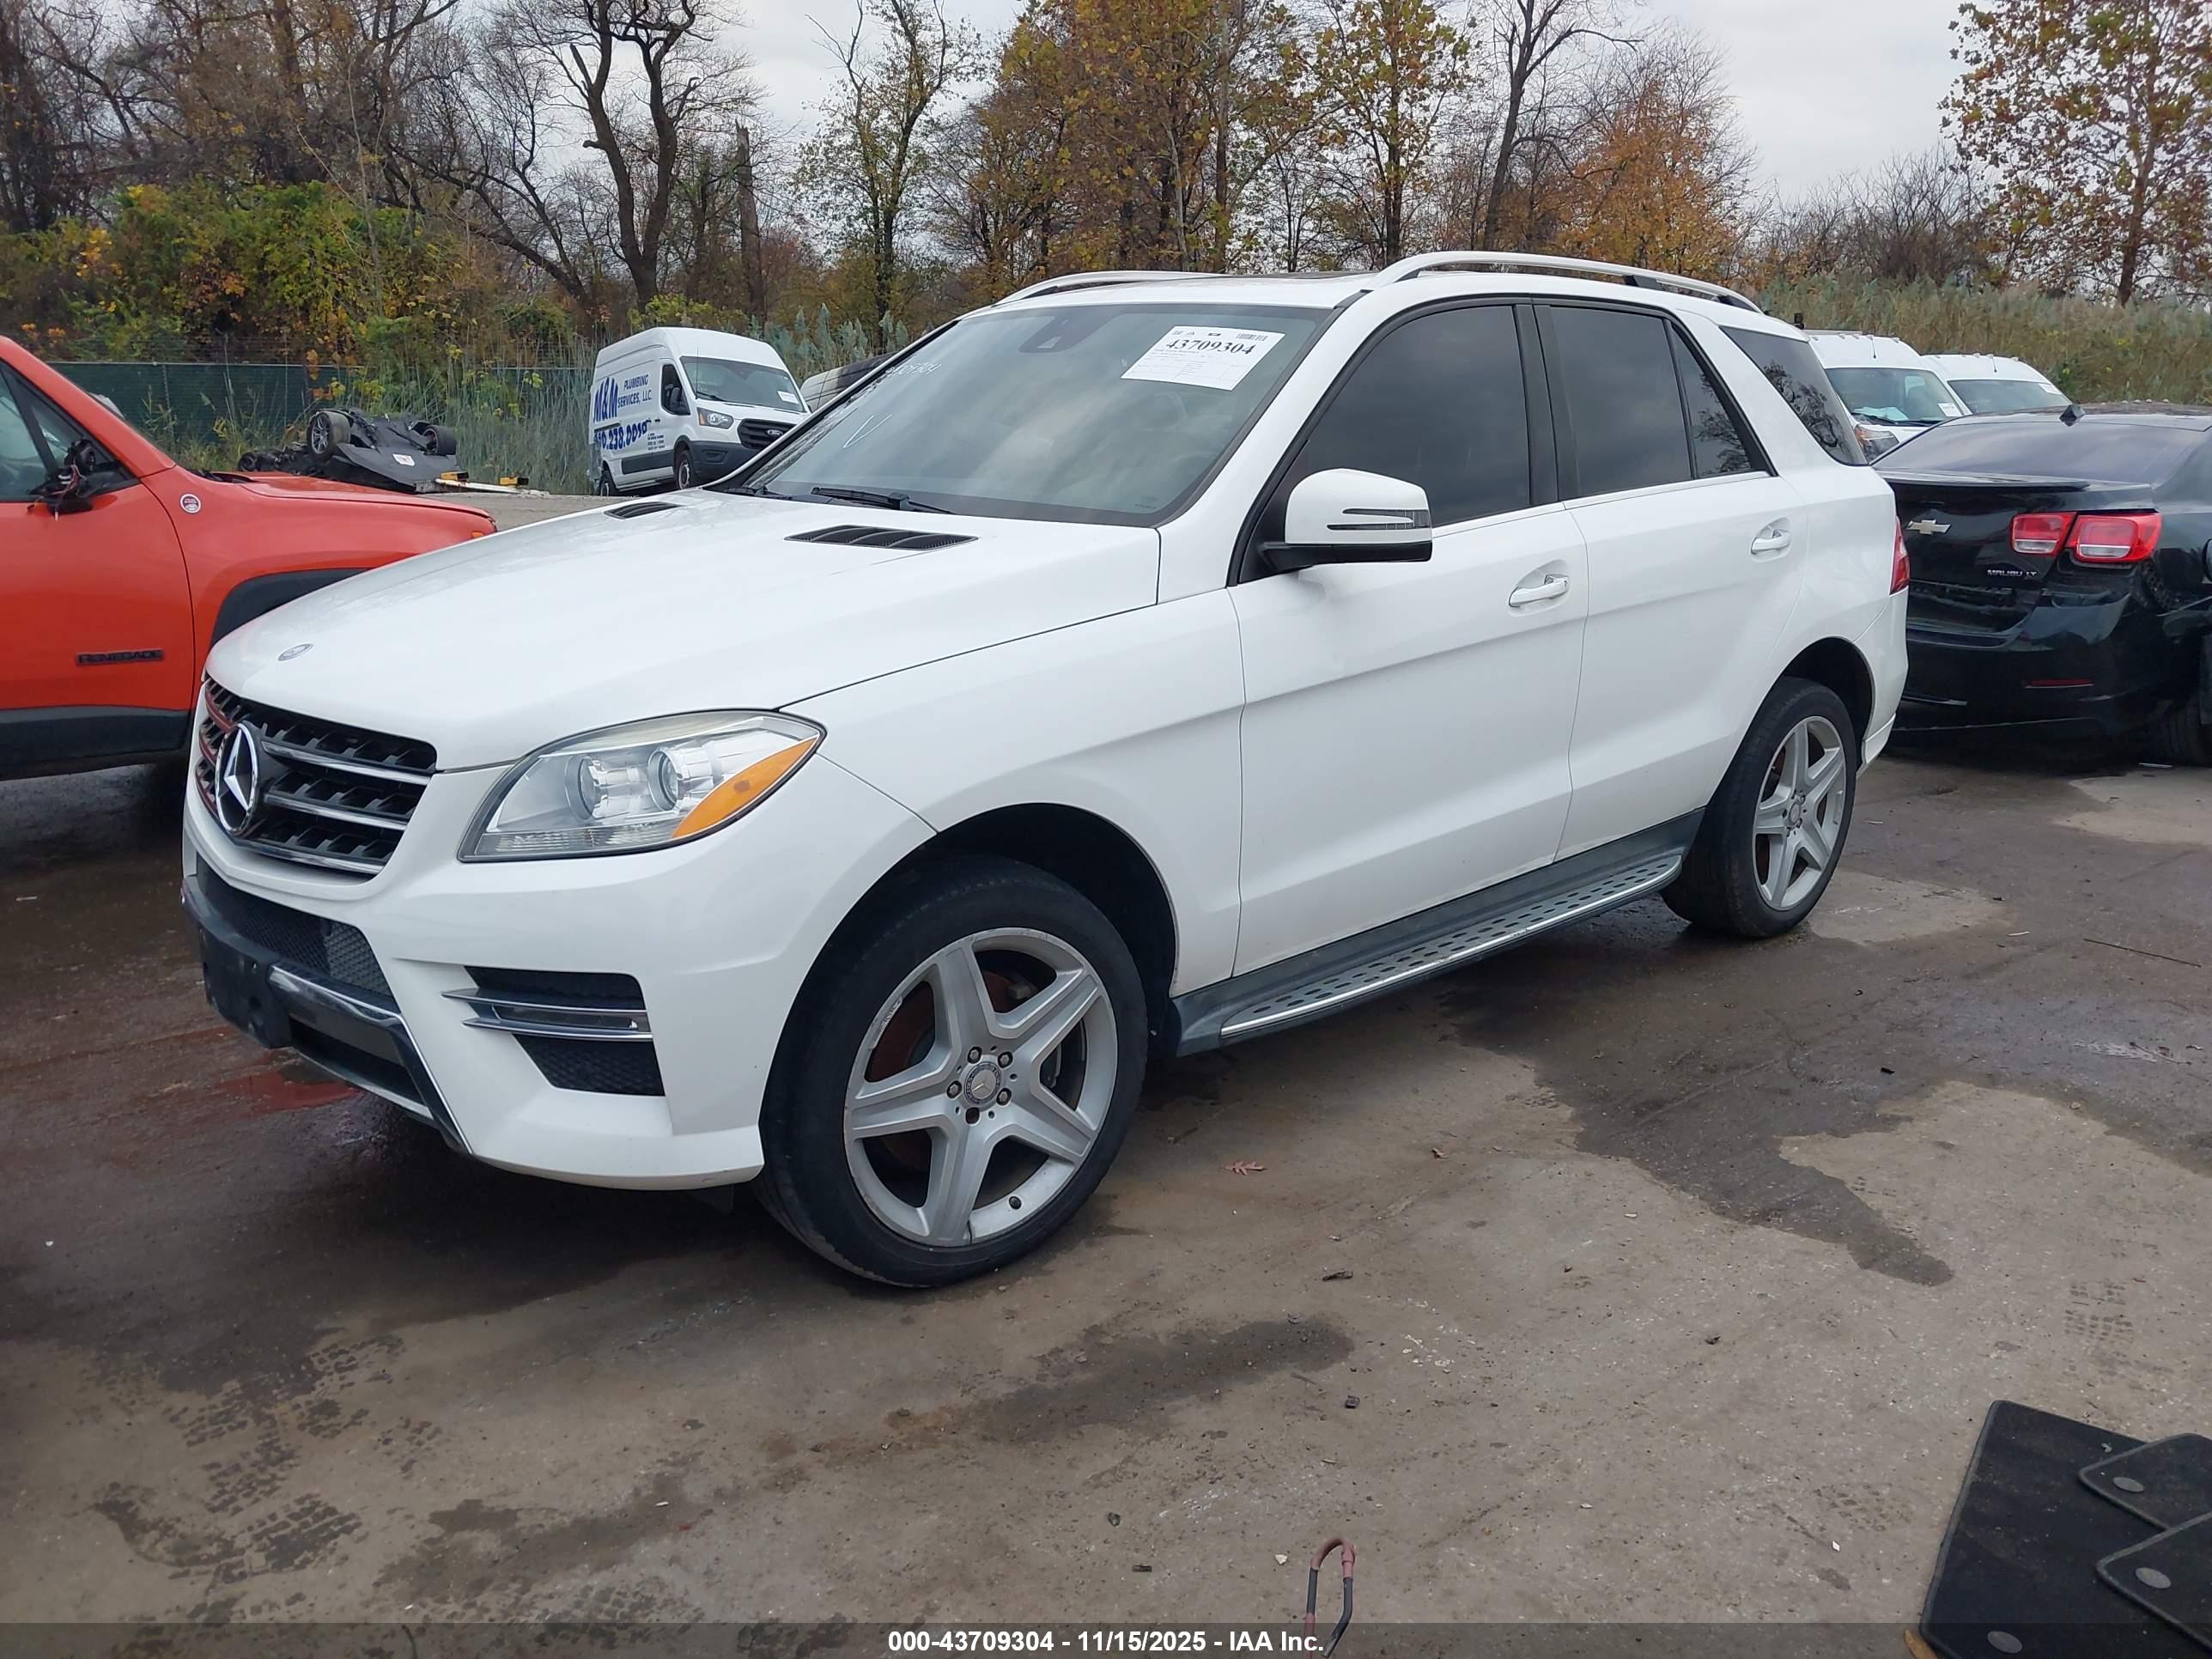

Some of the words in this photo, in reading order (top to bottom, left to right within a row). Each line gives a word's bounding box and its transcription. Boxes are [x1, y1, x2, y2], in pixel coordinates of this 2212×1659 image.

[1166, 338, 1257, 355] 43709304
[623, 374, 649, 391] PLUMBING
[593, 377, 619, 423] M&M
